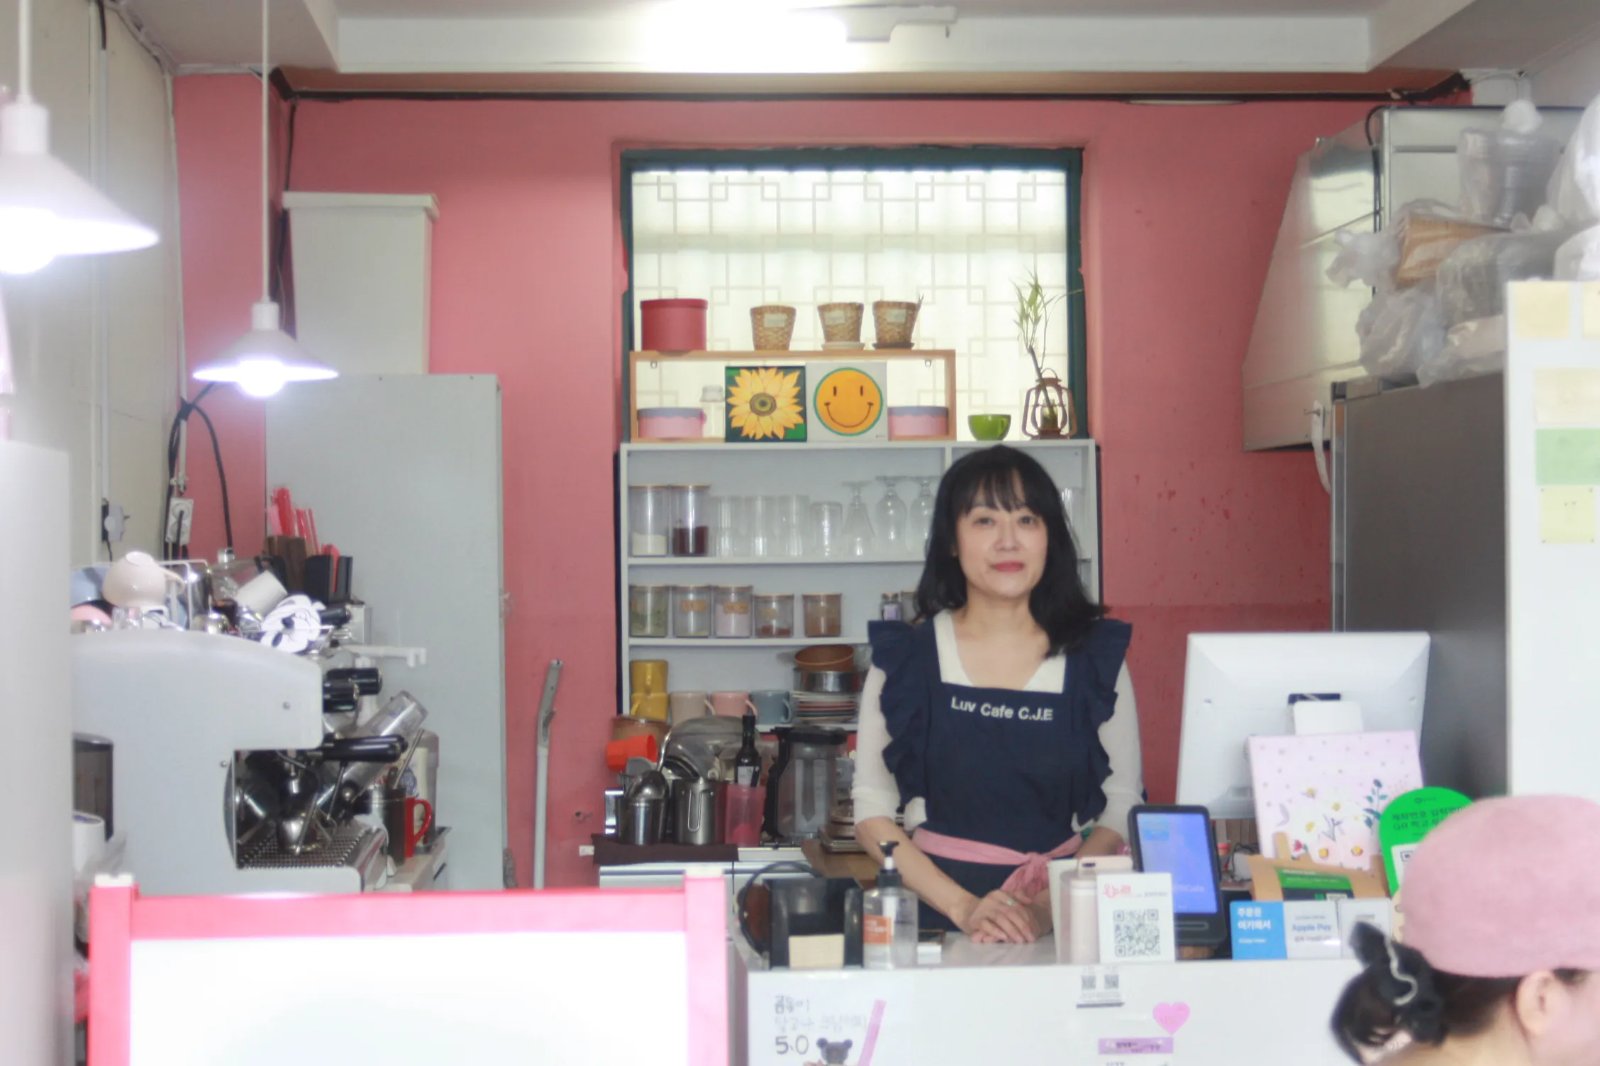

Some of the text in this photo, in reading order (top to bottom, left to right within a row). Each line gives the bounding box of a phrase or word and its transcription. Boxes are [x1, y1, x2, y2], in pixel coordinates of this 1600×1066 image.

[951, 696, 976, 712] Luv
[980, 702, 1014, 718] Cafe
[1292, 923, 1332, 932] Apple Pay
